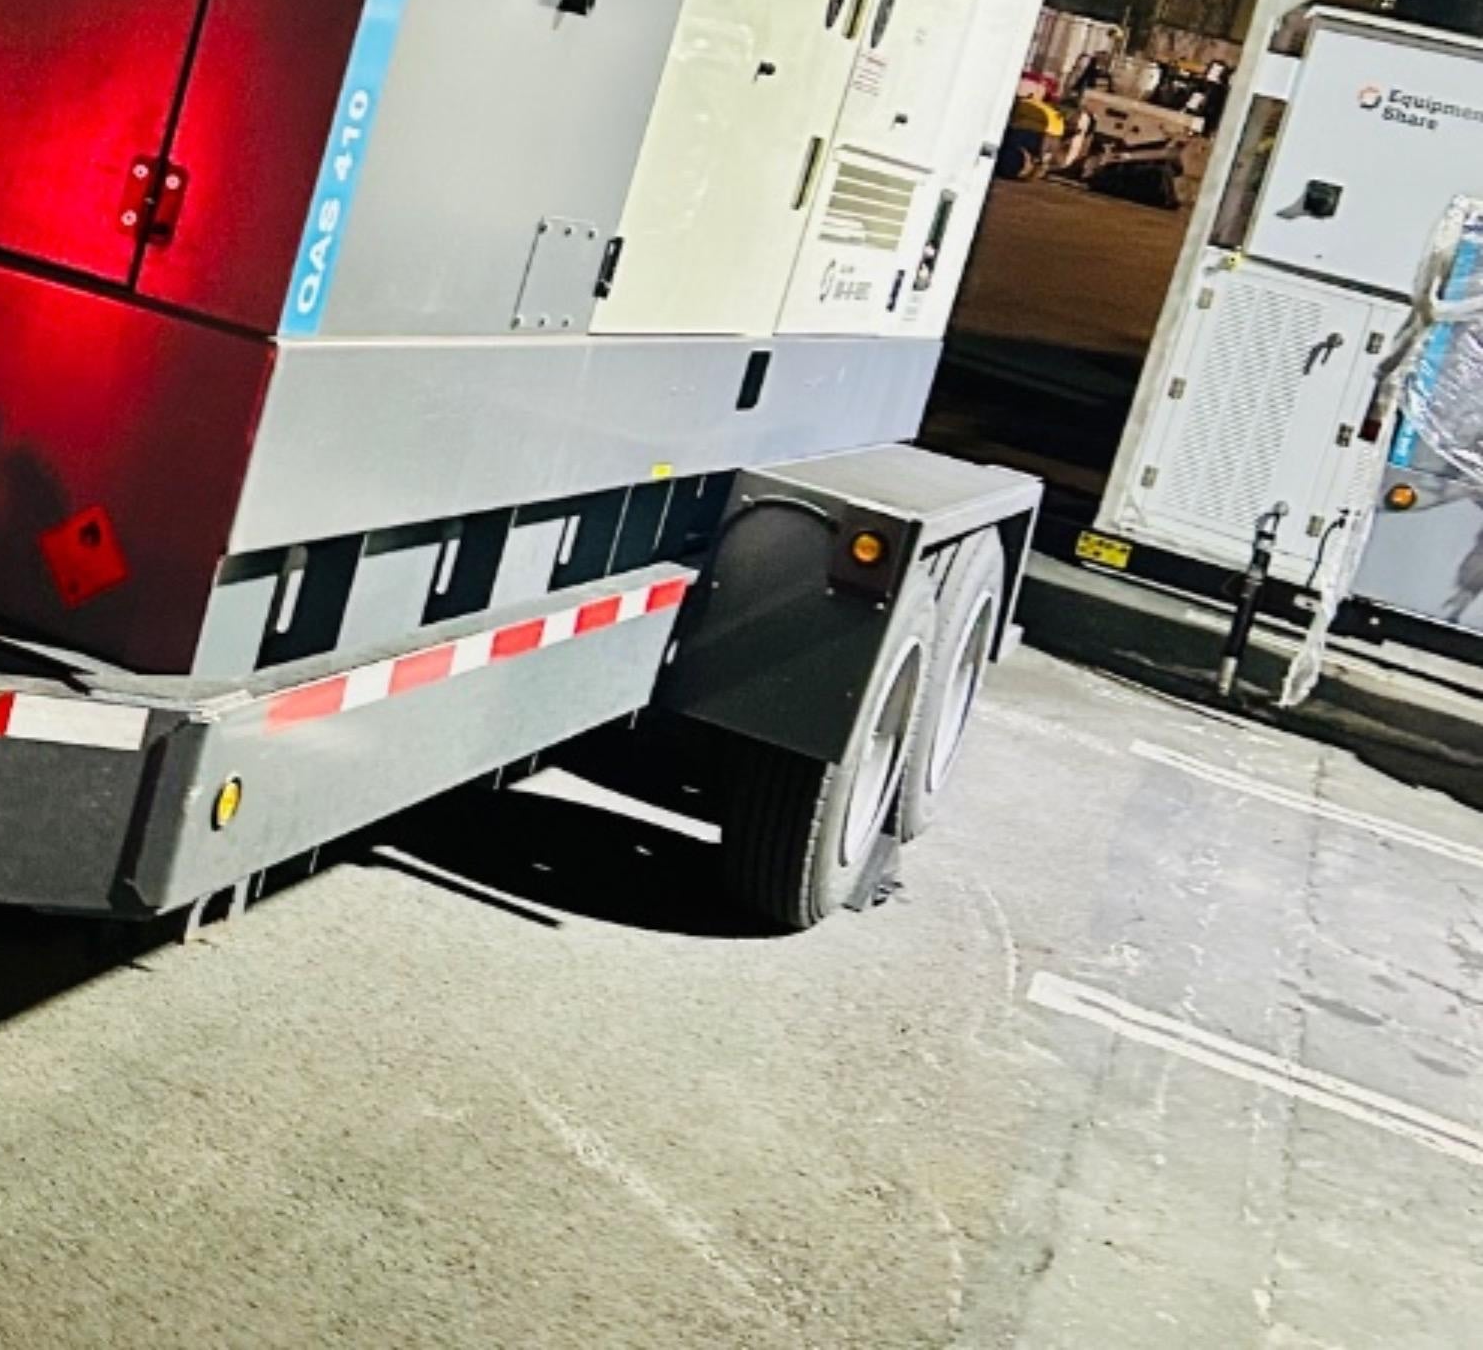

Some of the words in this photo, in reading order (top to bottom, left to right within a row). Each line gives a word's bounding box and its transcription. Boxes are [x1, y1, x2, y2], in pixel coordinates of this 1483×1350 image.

[1388, 88, 1483, 122] Equipmen
[297, 197, 342, 315] QAS
[333, 89, 370, 182] 410
